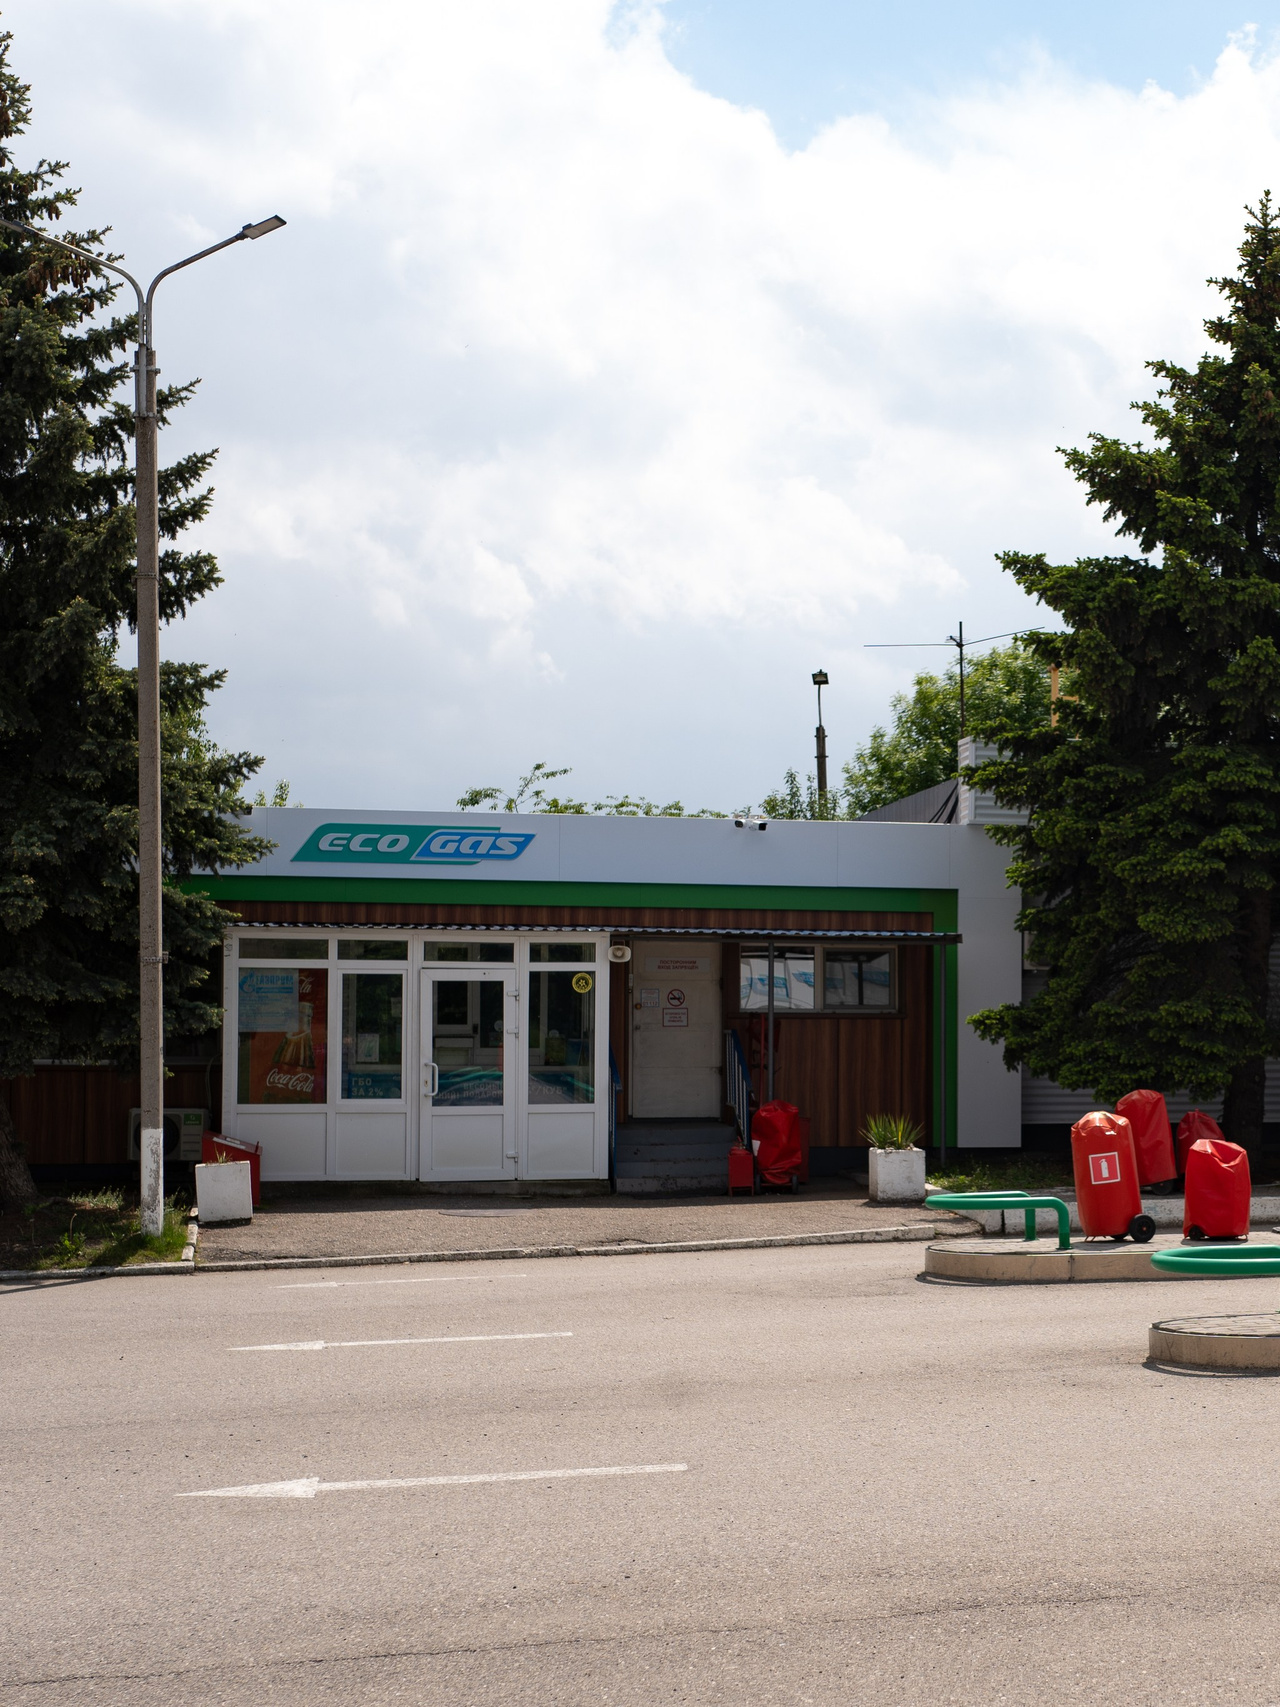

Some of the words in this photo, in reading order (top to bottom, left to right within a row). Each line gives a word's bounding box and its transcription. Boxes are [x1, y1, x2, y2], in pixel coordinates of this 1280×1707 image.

[318, 833, 410, 853] ECO
[266, 1068, 314, 1092] Coca-Cola
[351, 1077, 372, 1086] ГБО
